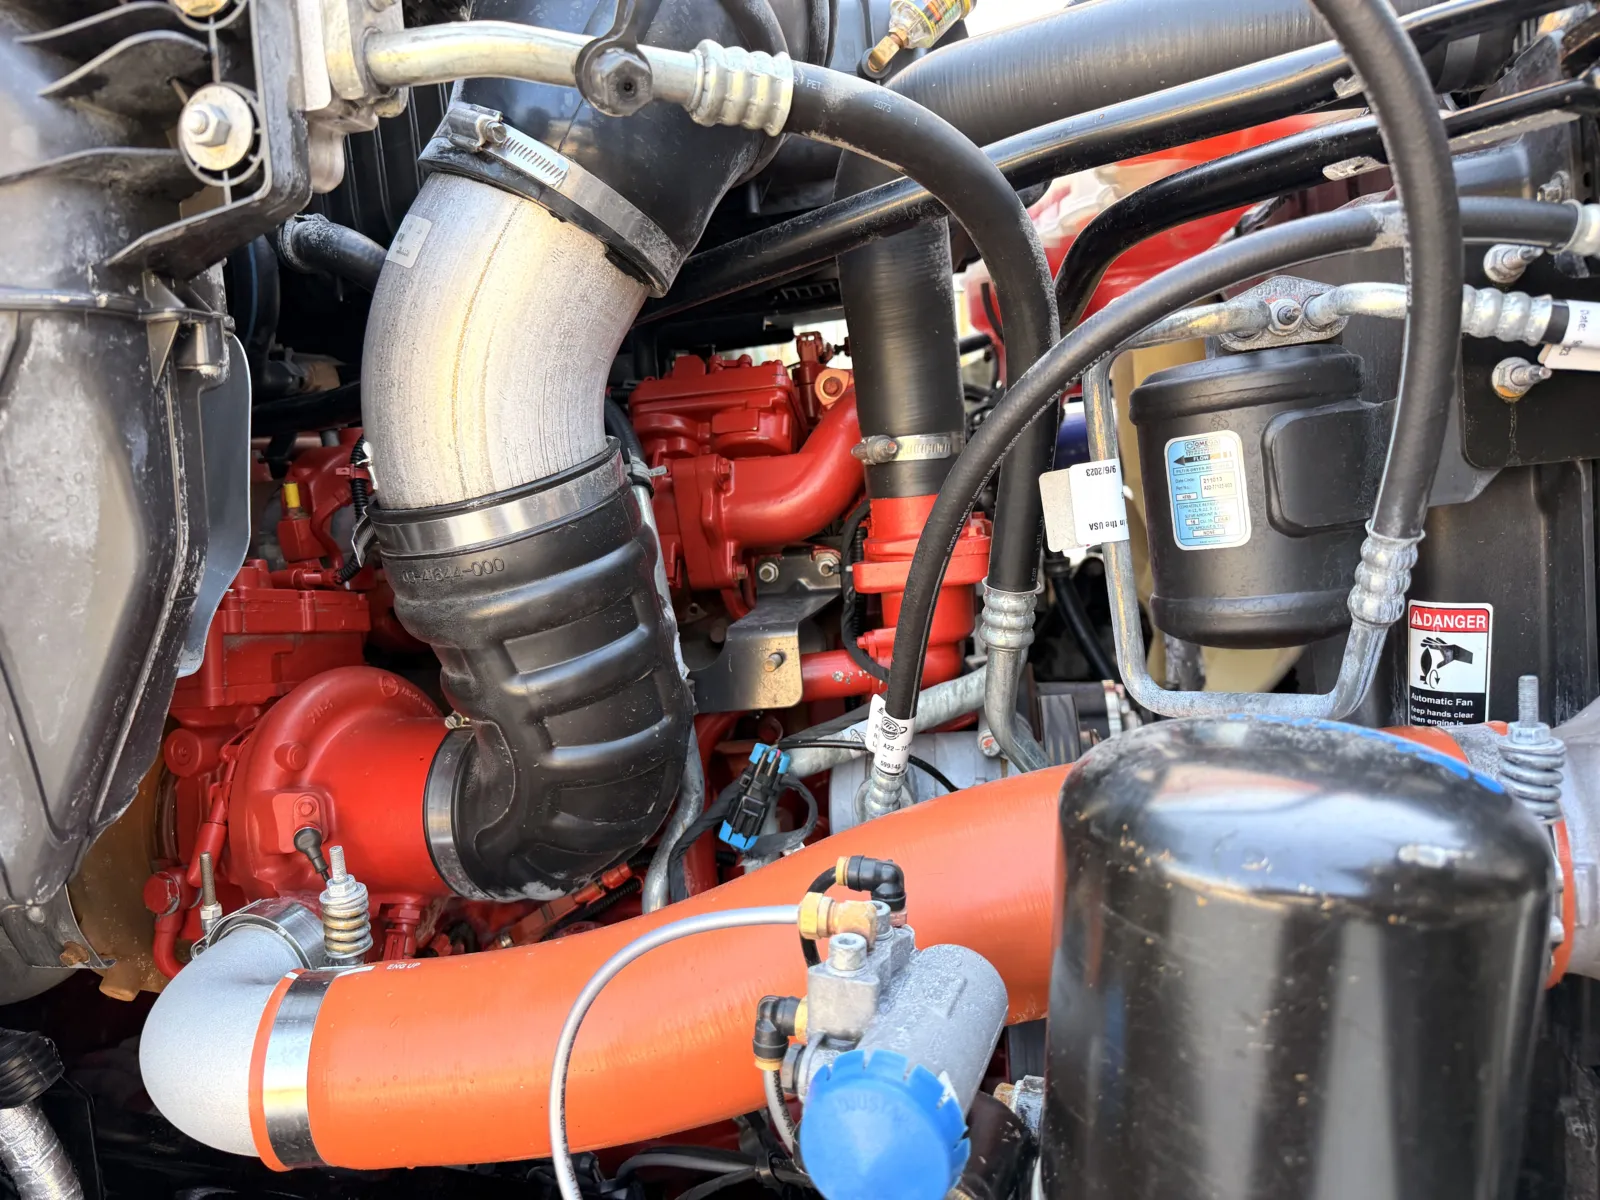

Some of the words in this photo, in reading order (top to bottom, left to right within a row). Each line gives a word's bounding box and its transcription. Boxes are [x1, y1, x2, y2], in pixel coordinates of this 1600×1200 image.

[806, 79, 821, 91] PET
[874, 100, 892, 113] 2073
[1085, 464, 1117, 477] 9/6/2023
[1088, 521, 1104, 531] USA
[1105, 520, 1118, 530] the
[1423, 614, 1486, 628] DANGER
[1411, 692, 1453, 706] Automatic
[1455, 698, 1474, 707] Fan
[1411, 705, 1425, 715] Keep
[1426, 708, 1452, 718] hands
[1453, 711, 1474, 719] clear
[1410, 714, 1426, 723] when
[1427, 717, 1454, 727] engine
[386, 962, 407, 970] ENG
